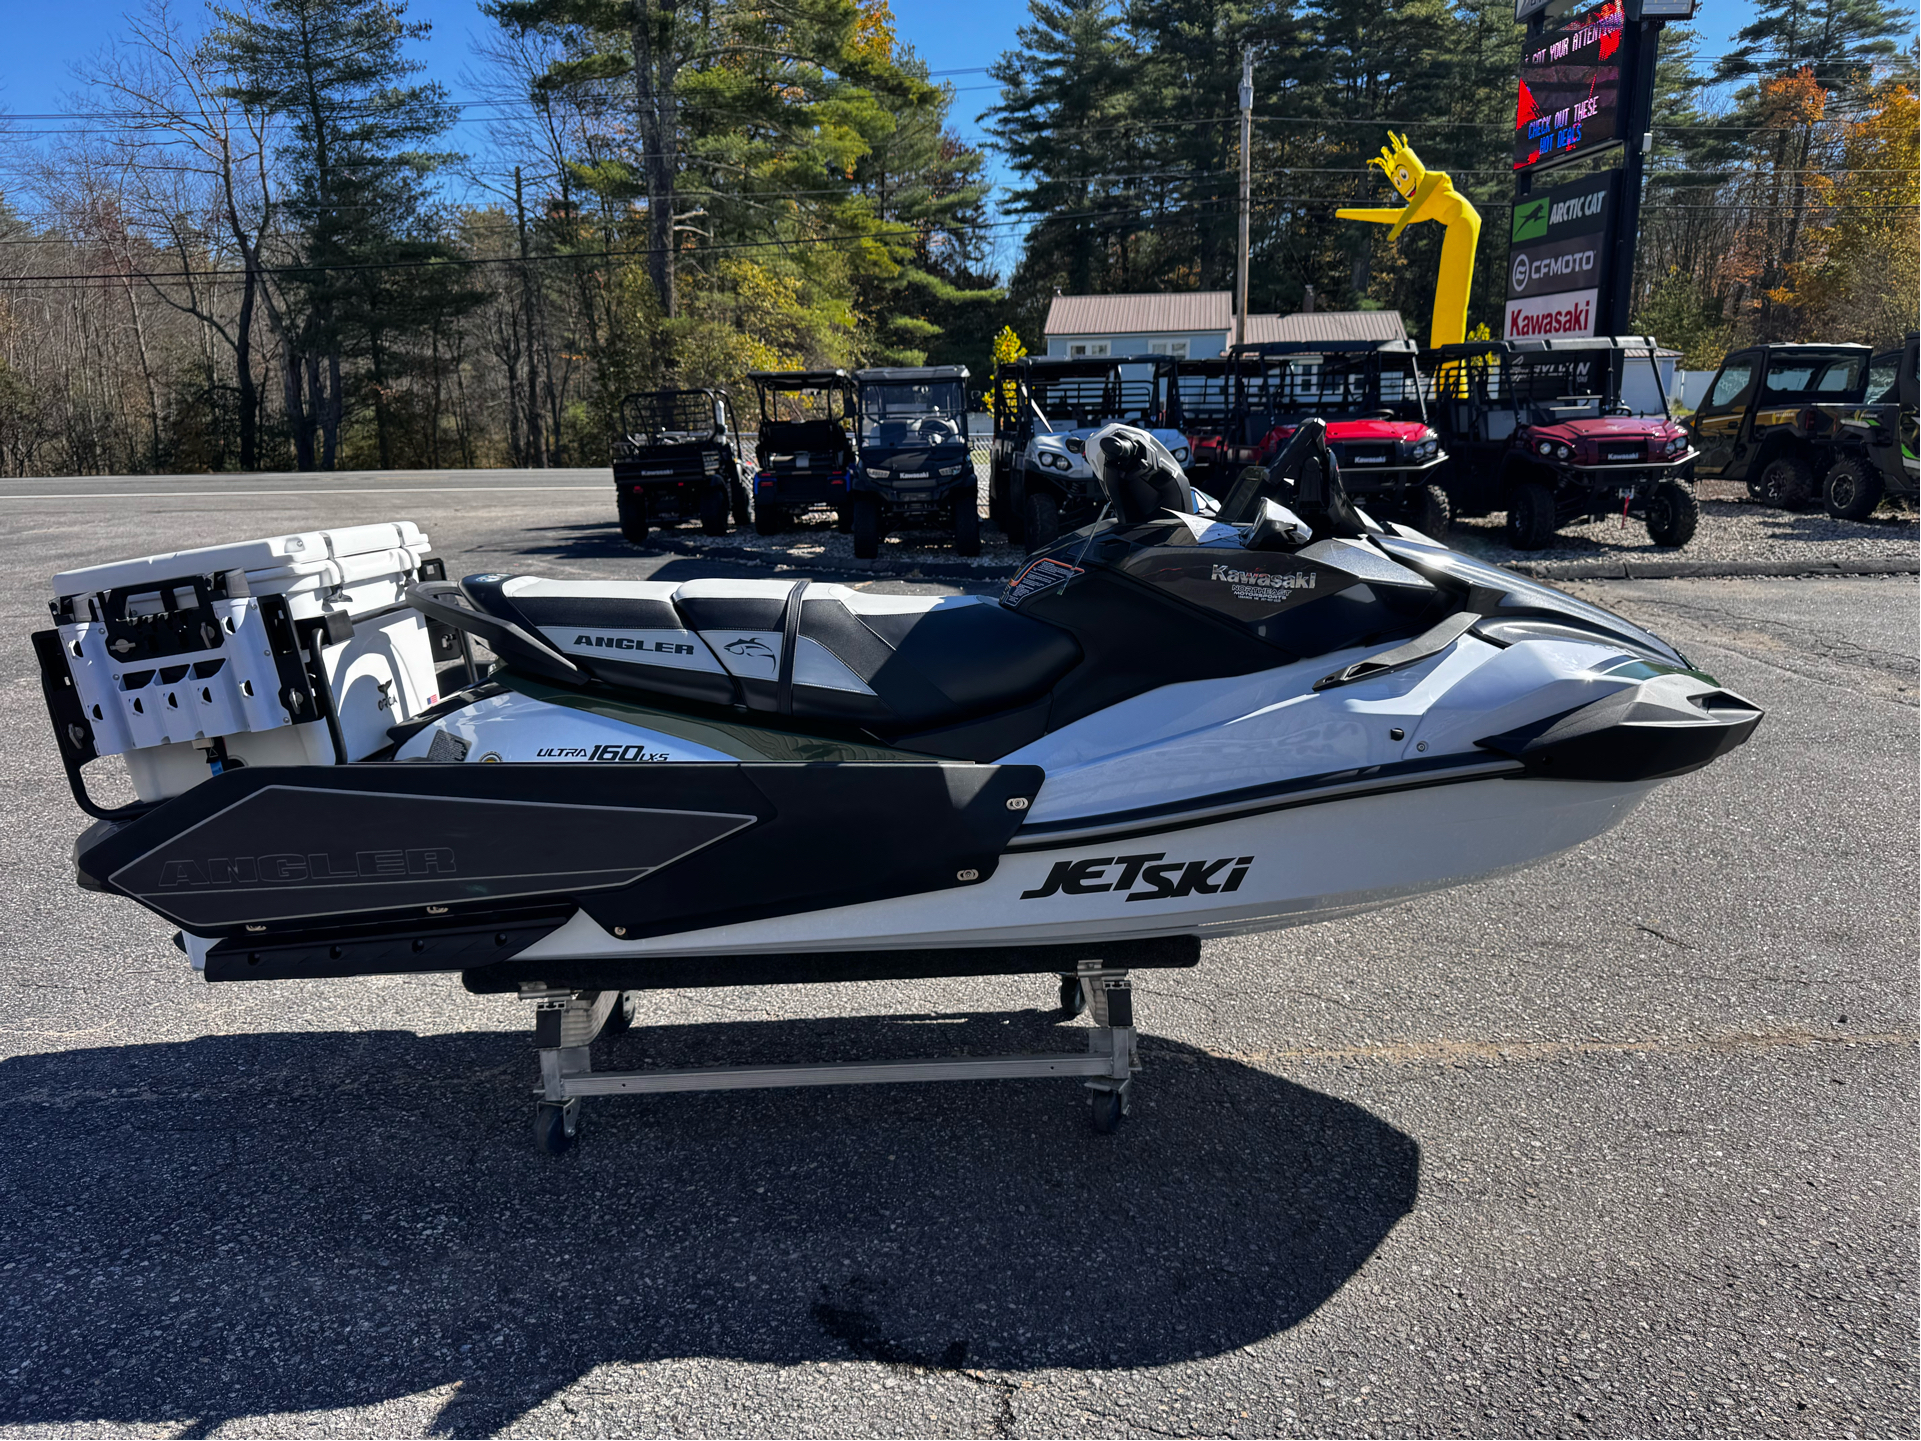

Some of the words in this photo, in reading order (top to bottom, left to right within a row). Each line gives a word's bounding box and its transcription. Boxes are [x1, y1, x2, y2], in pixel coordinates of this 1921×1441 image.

[1549, 37, 1569, 62] YOUR
[1528, 115, 1551, 139] CHECK
[1554, 108, 1570, 129] OUT
[1573, 96, 1599, 122] THESE
[1539, 133, 1554, 155] HOT
[1557, 122, 1582, 148] DEALS
[1549, 195, 1585, 225] ARCTIC
[1584, 190, 1606, 216] CAT
[1531, 252, 1594, 279] CFMOTO
[1510, 300, 1590, 337] Kawasaki
[1607, 452, 1639, 460] Kawasaki
[1211, 564, 1317, 589] Kawasaki
[1231, 584, 1292, 597] NORTHEAST
[1233, 590, 1287, 600] MOTORSPORTS
[573, 635, 694, 655] ANGLER
[536, 748, 587, 757] ULTRA
[588, 744, 645, 761] 160
[158, 847, 457, 887] ANGLER
